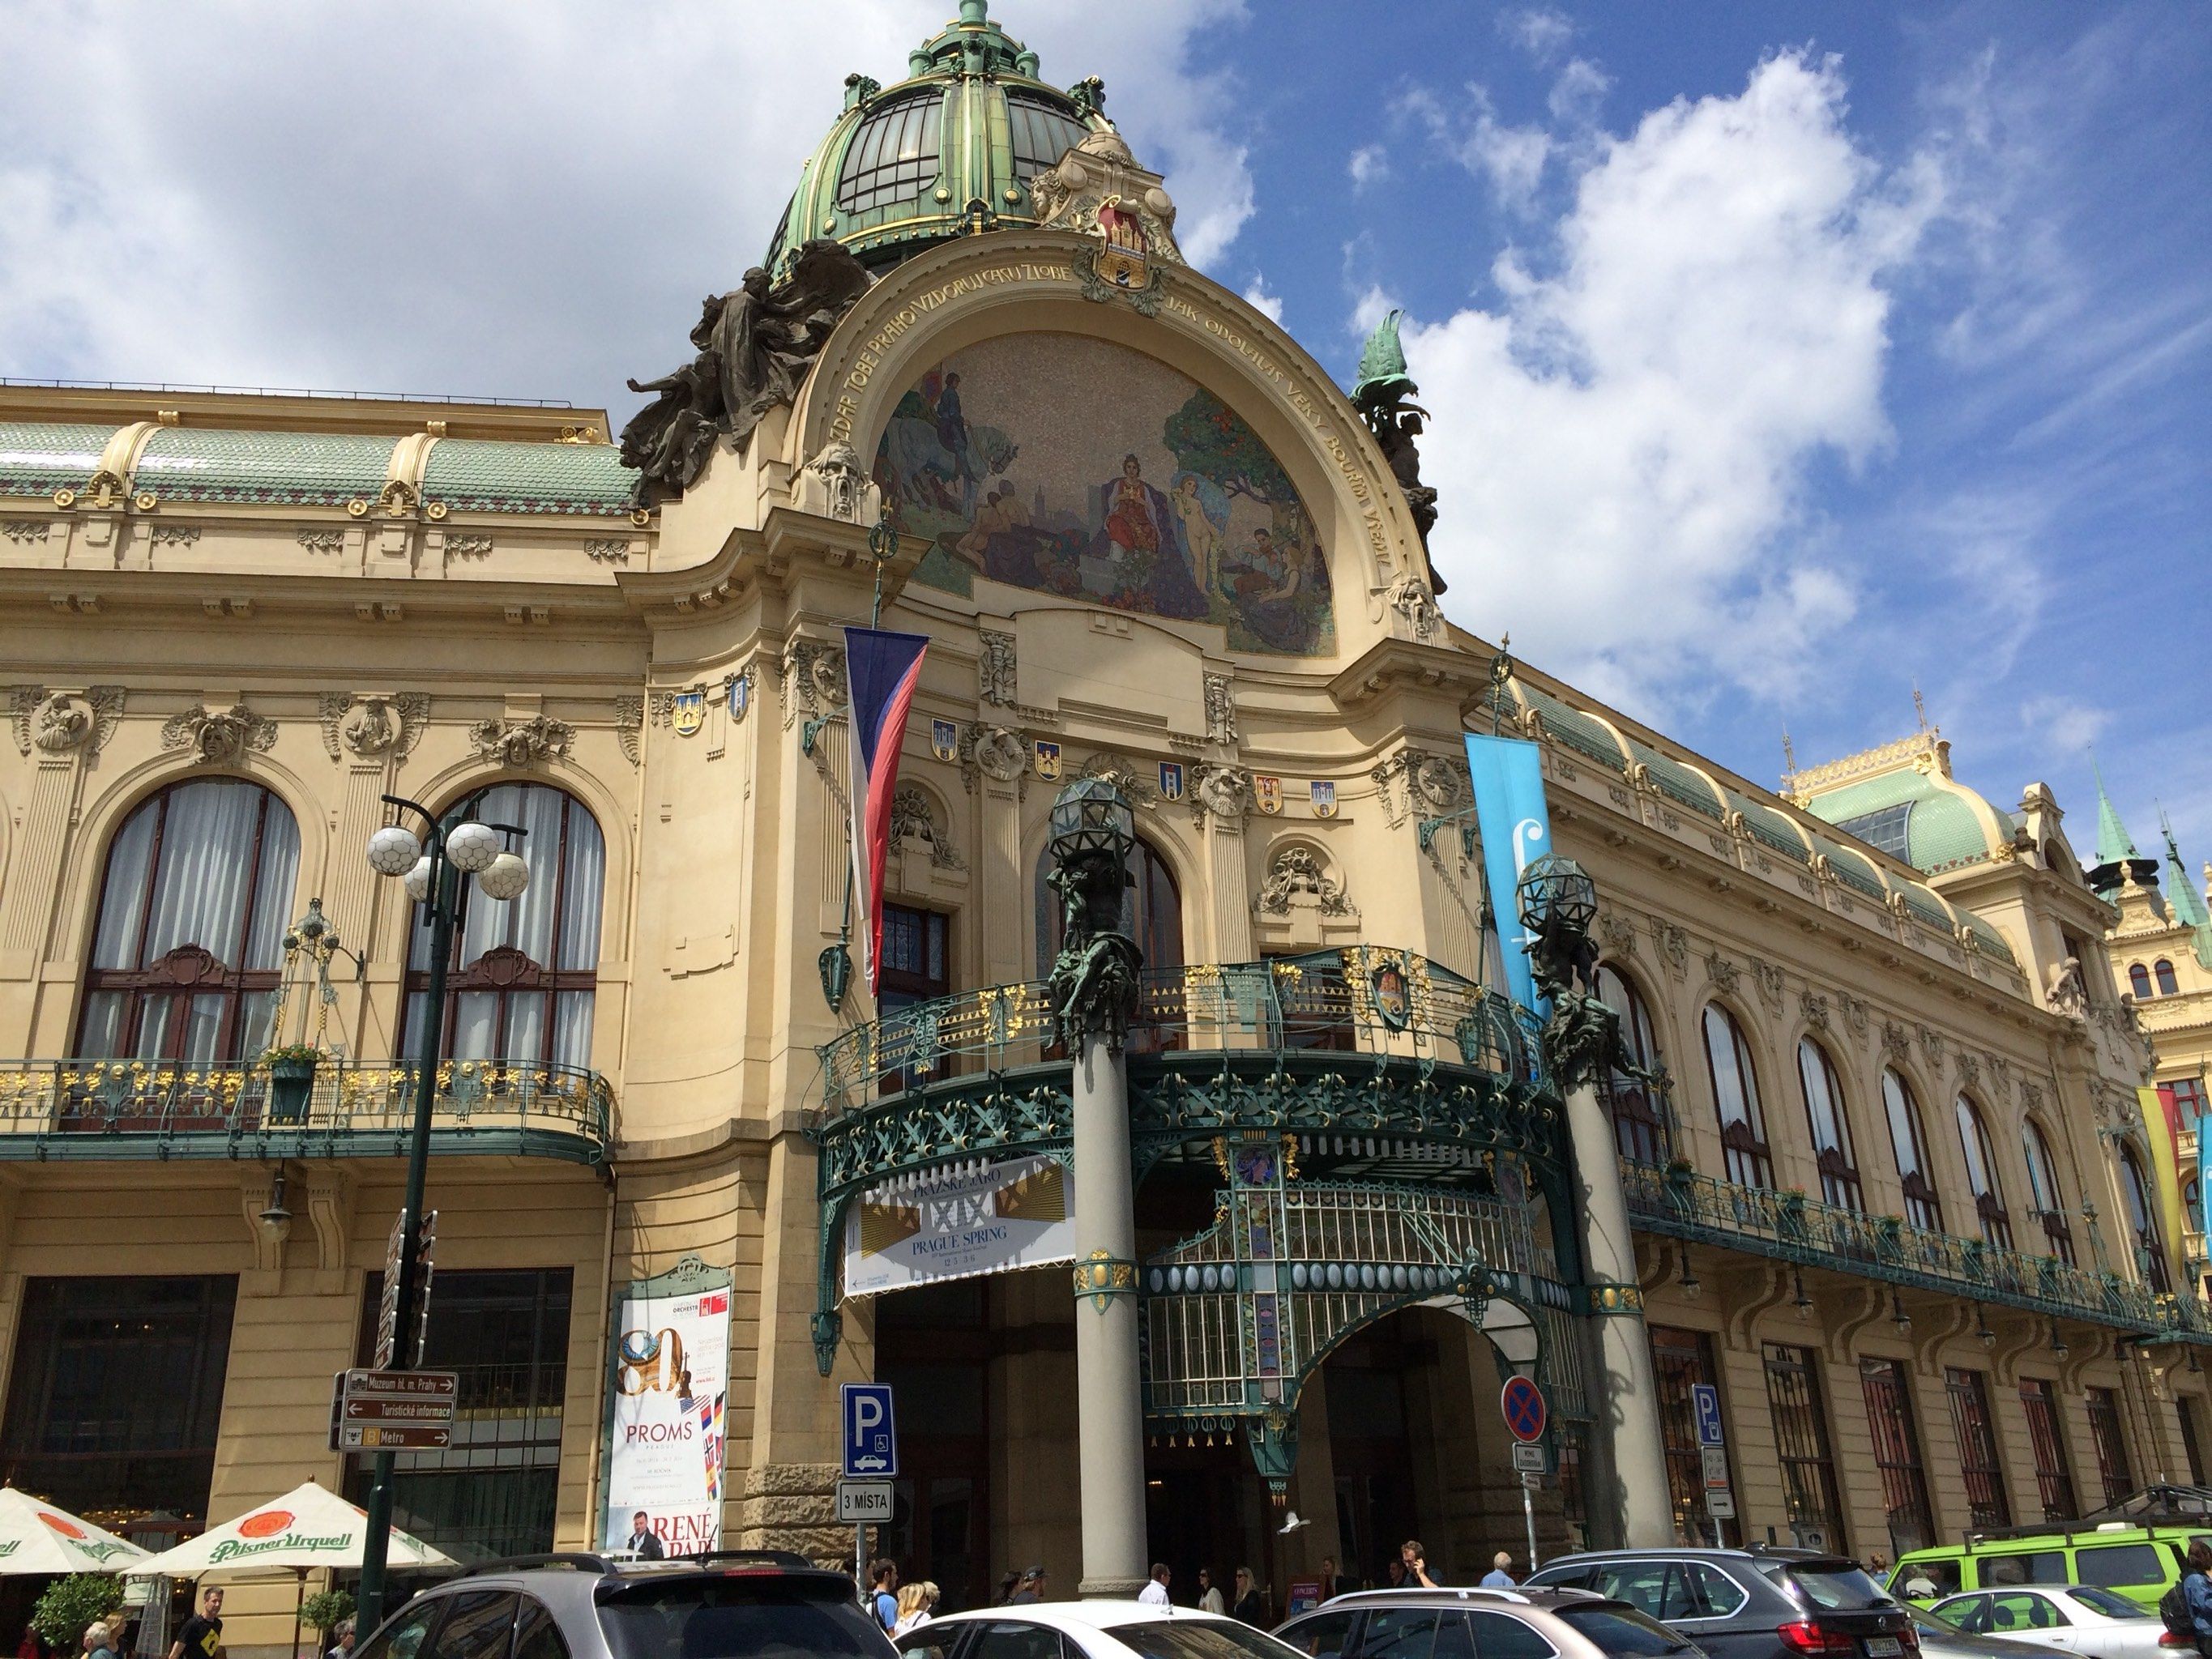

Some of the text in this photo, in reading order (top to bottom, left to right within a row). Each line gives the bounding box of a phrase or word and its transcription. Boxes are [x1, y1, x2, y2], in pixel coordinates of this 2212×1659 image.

[1165, 296, 1202, 322] JAK
[1205, 319, 1284, 383] ODOLALAS
[830, 394, 858, 442] ZDAR
[912, 1225, 1007, 1256] PRAGUE SPRING
[368, 1376, 396, 1390] Muzeum
[417, 1378, 437, 1393] Prahy
[381, 1403, 451, 1418] Turistické informace
[855, 1395, 883, 1447] P
[1699, 1392, 1714, 1426] P
[381, 1431, 405, 1443] Metro
[626, 1421, 693, 1444] PROMS
[844, 1491, 888, 1509] 3 MÍSTA
[653, 1507, 711, 1542] RENÉ
[208, 1533, 352, 1564] Pilsner Urquell
